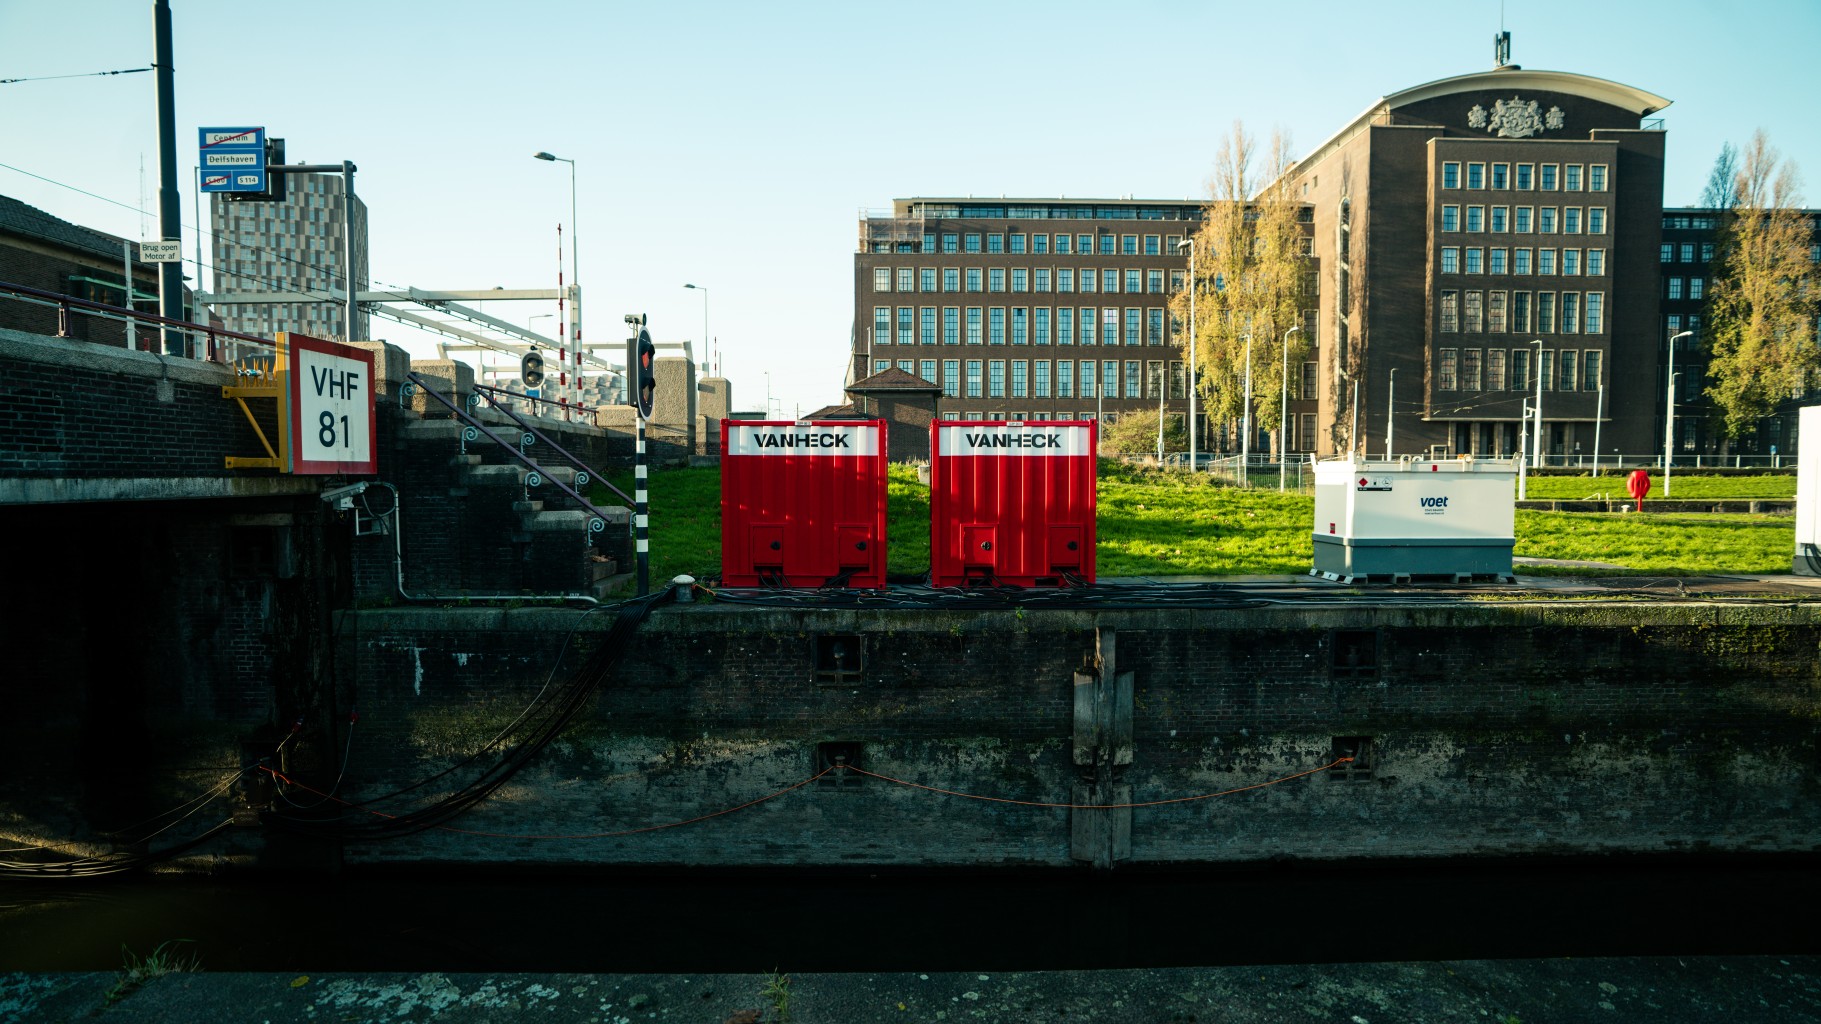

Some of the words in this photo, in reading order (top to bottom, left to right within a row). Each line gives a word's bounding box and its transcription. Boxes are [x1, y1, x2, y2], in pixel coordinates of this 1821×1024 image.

[213, 134, 248, 142] Centrum
[142, 244, 159, 252] Brug
[311, 365, 359, 401] VHF
[319, 410, 349, 449] 81
[753, 433, 849, 448] VANHECK
[966, 433, 1062, 448] VANHECK
[1420, 496, 1449, 508] voet
